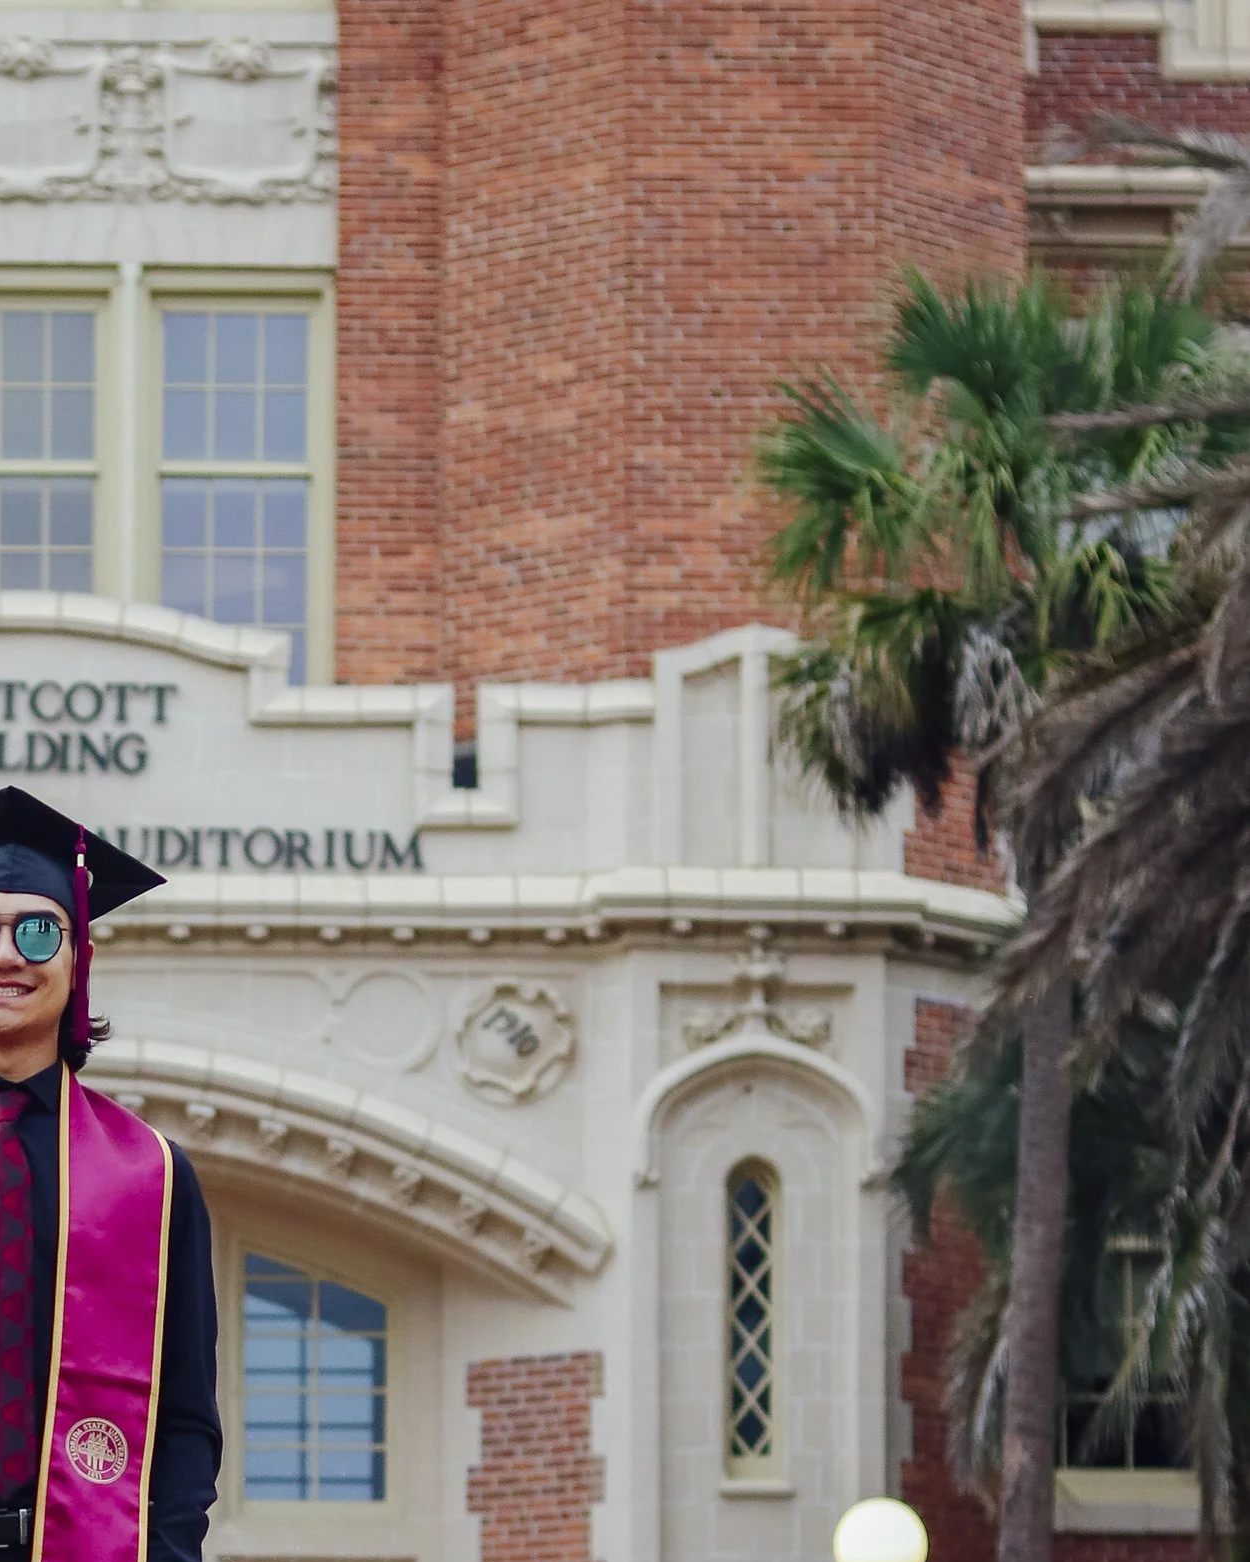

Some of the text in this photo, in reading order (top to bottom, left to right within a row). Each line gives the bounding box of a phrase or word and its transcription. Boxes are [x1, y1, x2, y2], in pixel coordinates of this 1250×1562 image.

[481, 1006, 540, 1058] 1910
[69, 1421, 126, 1474] FLORIDA STATE UNIVERSITY
